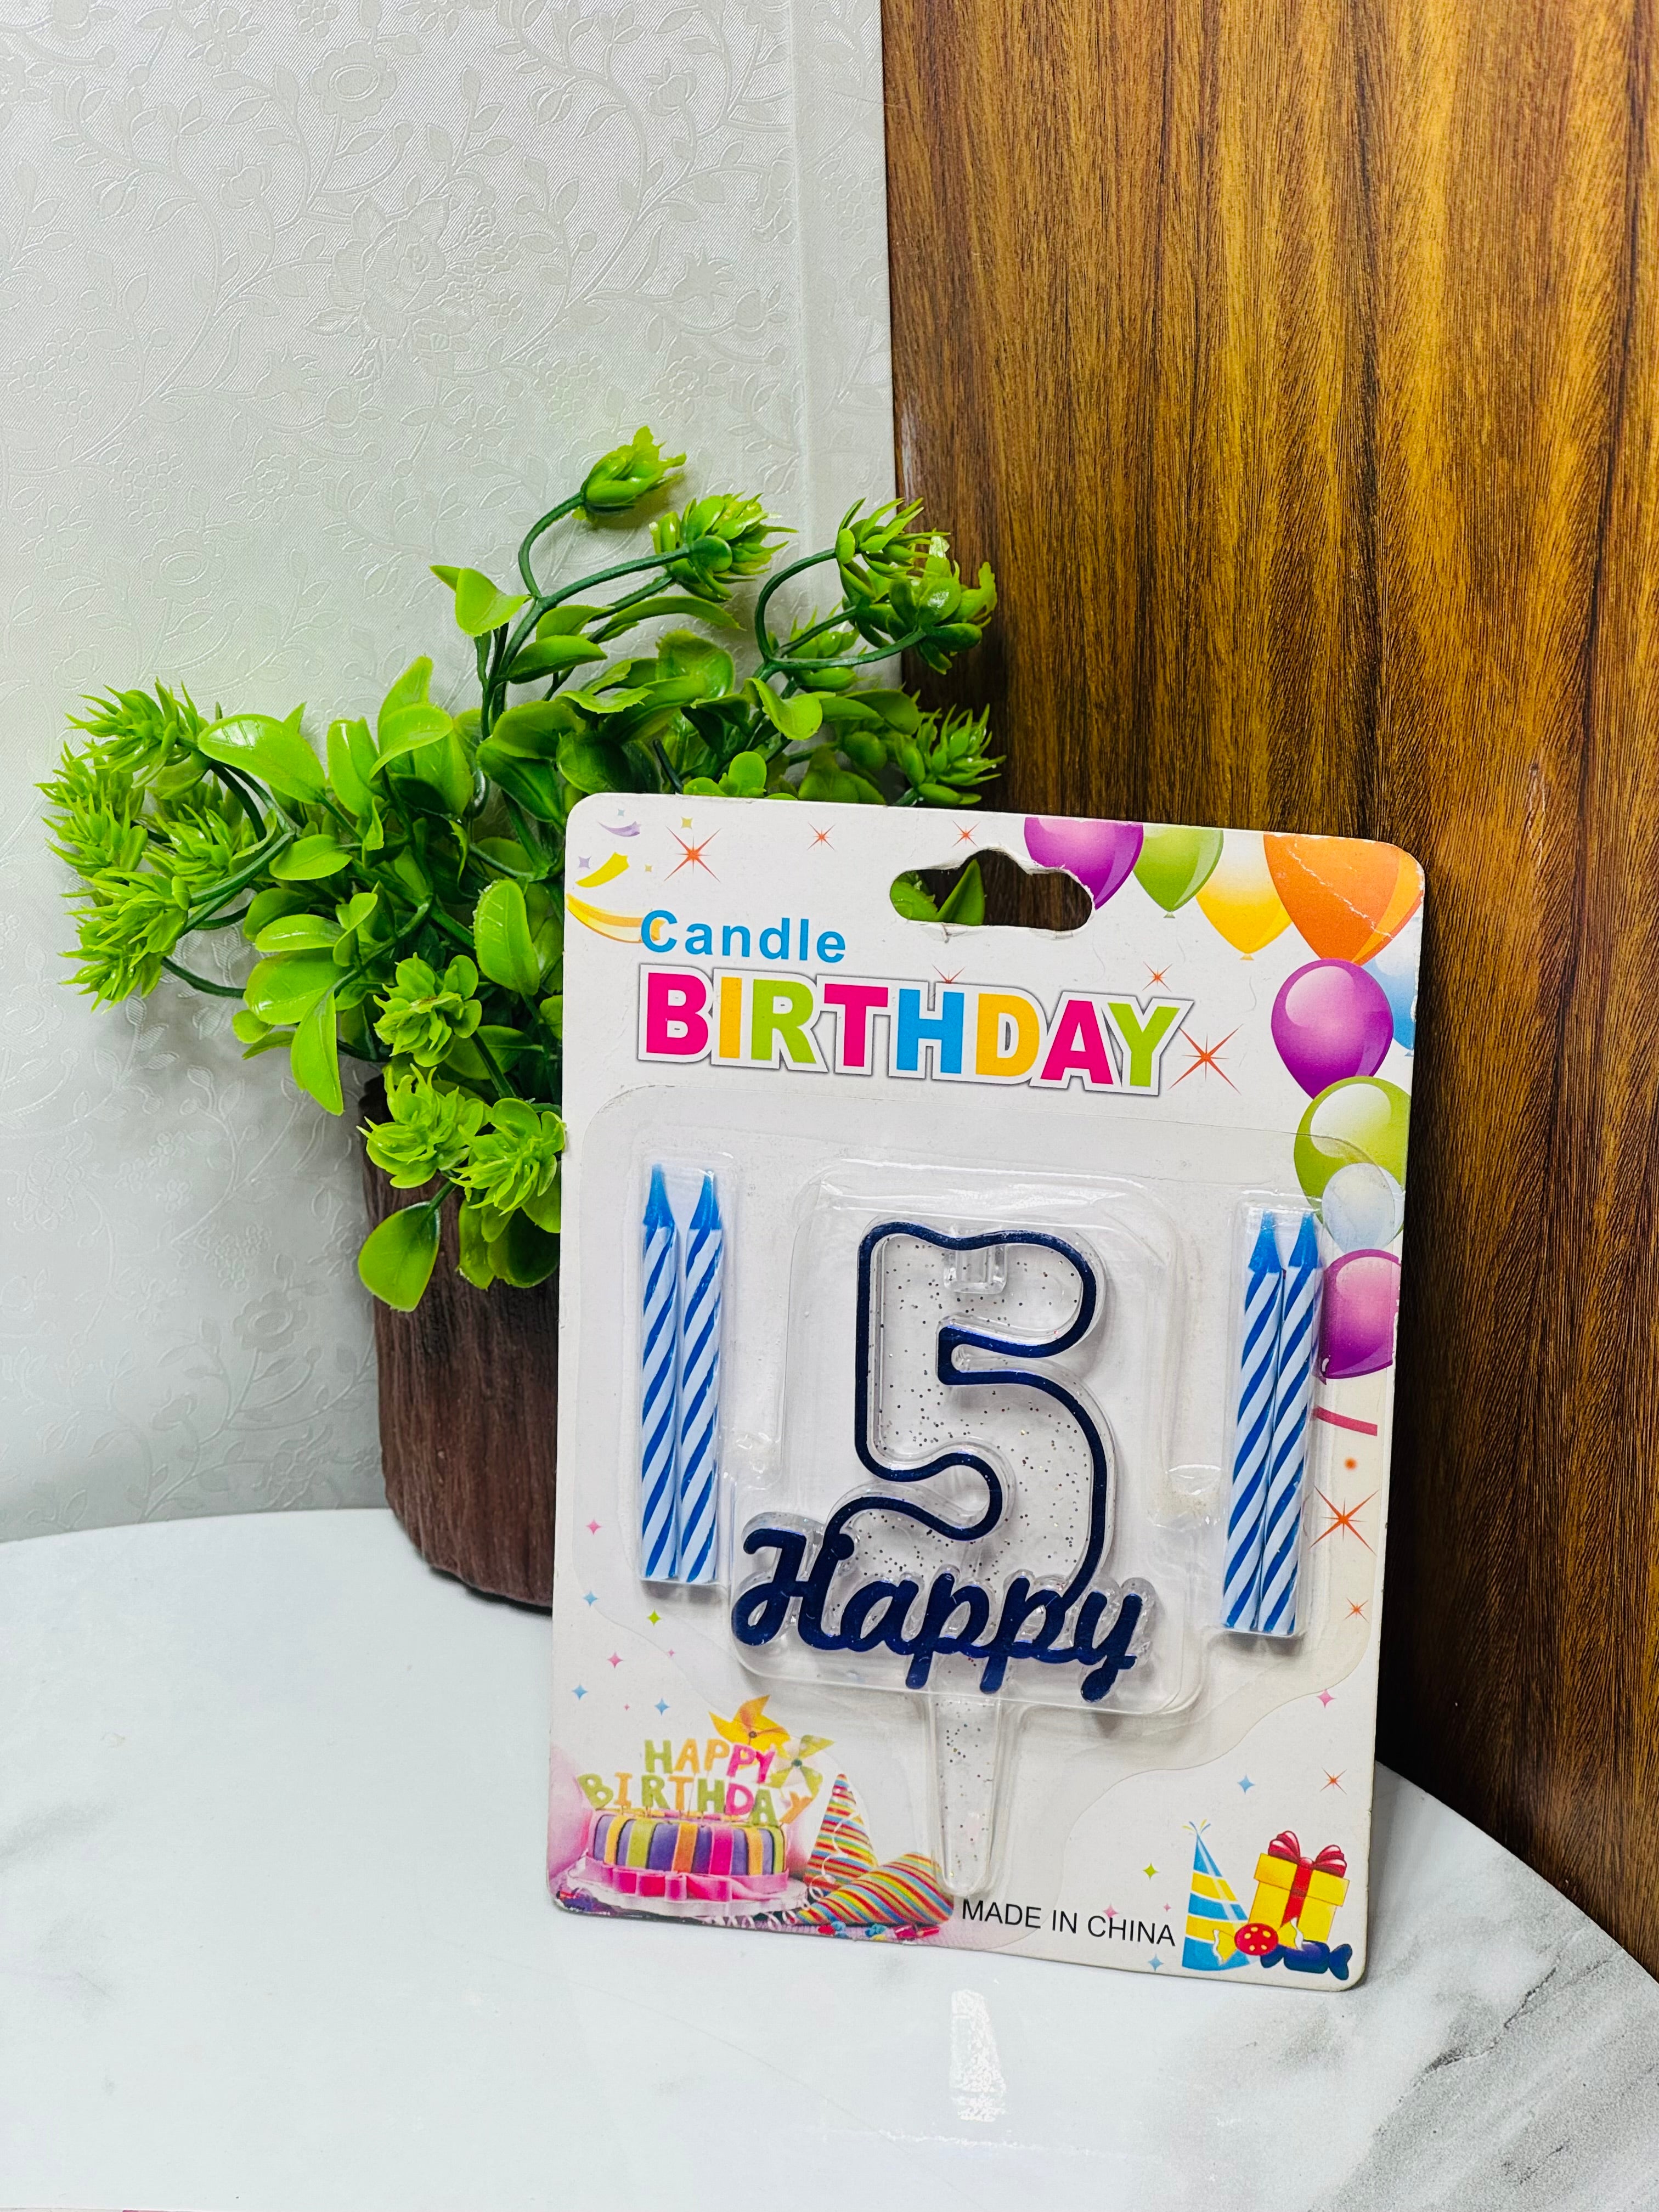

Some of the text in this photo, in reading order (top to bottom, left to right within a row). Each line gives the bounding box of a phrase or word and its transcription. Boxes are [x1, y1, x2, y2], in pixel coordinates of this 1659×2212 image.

[641, 910, 846, 963] Candle
[640, 968, 1189, 1092] BIRTHDAY
[842, 1221, 1108, 1591] 5
[731, 1528, 1143, 1702] Happy
[644, 1738, 776, 1784] HAPPY
[577, 1771, 813, 1826] BIRTHDAY
[961, 1899, 1176, 1947] MADE IN CHINA
